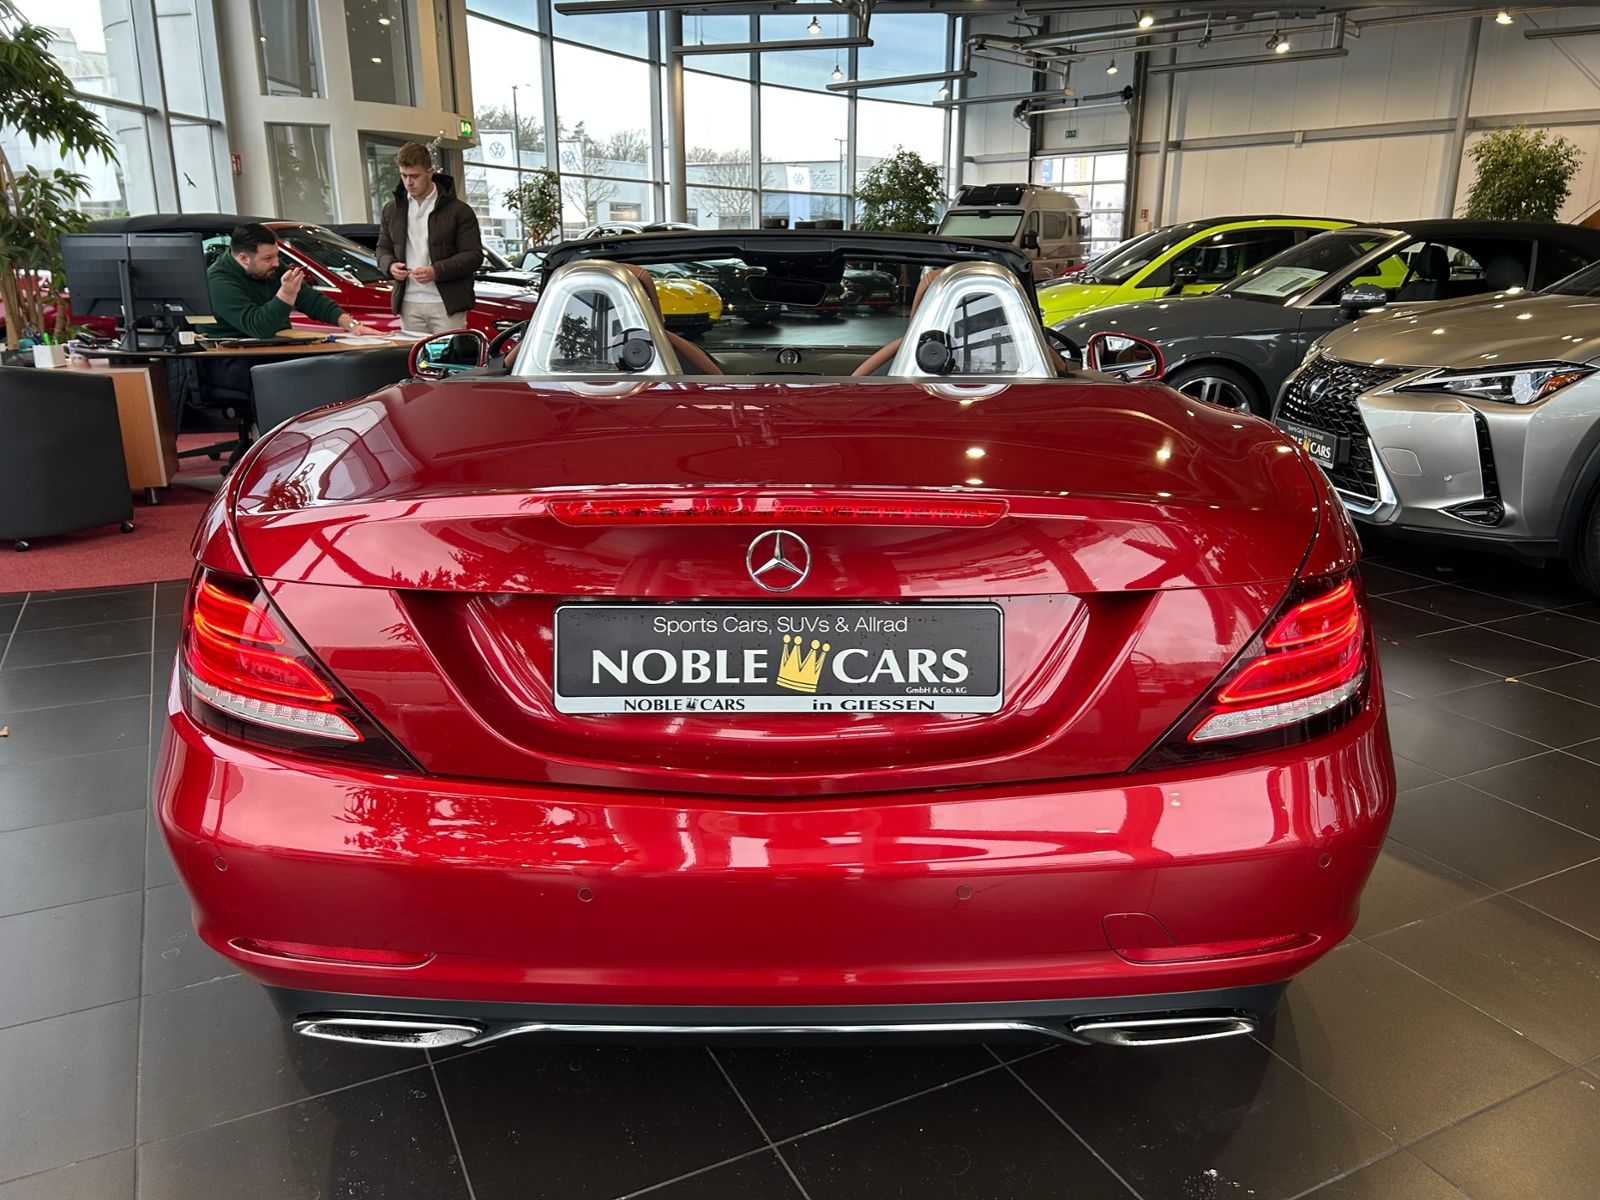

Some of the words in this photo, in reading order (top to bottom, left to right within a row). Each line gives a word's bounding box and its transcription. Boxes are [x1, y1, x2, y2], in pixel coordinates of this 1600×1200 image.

[1310, 442, 1331, 459] CARS
[653, 616, 718, 636] Sports
[723, 616, 772, 635] Cars,
[777, 616, 830, 633] SUVs
[834, 616, 850, 633] &
[854, 616, 908, 633] Allrad
[592, 649, 769, 685] NOBLE
[832, 648, 970, 685] CARS
[905, 686, 931, 694] GmbH
[932, 686, 939, 694] &
[940, 686, 954, 694] Co.
[955, 686, 967, 694] KG
[624, 698, 682, 711] NOBLE
[701, 698, 745, 711] CARS
[812, 699, 832, 711] in
[840, 699, 935, 711] GIESSEN
